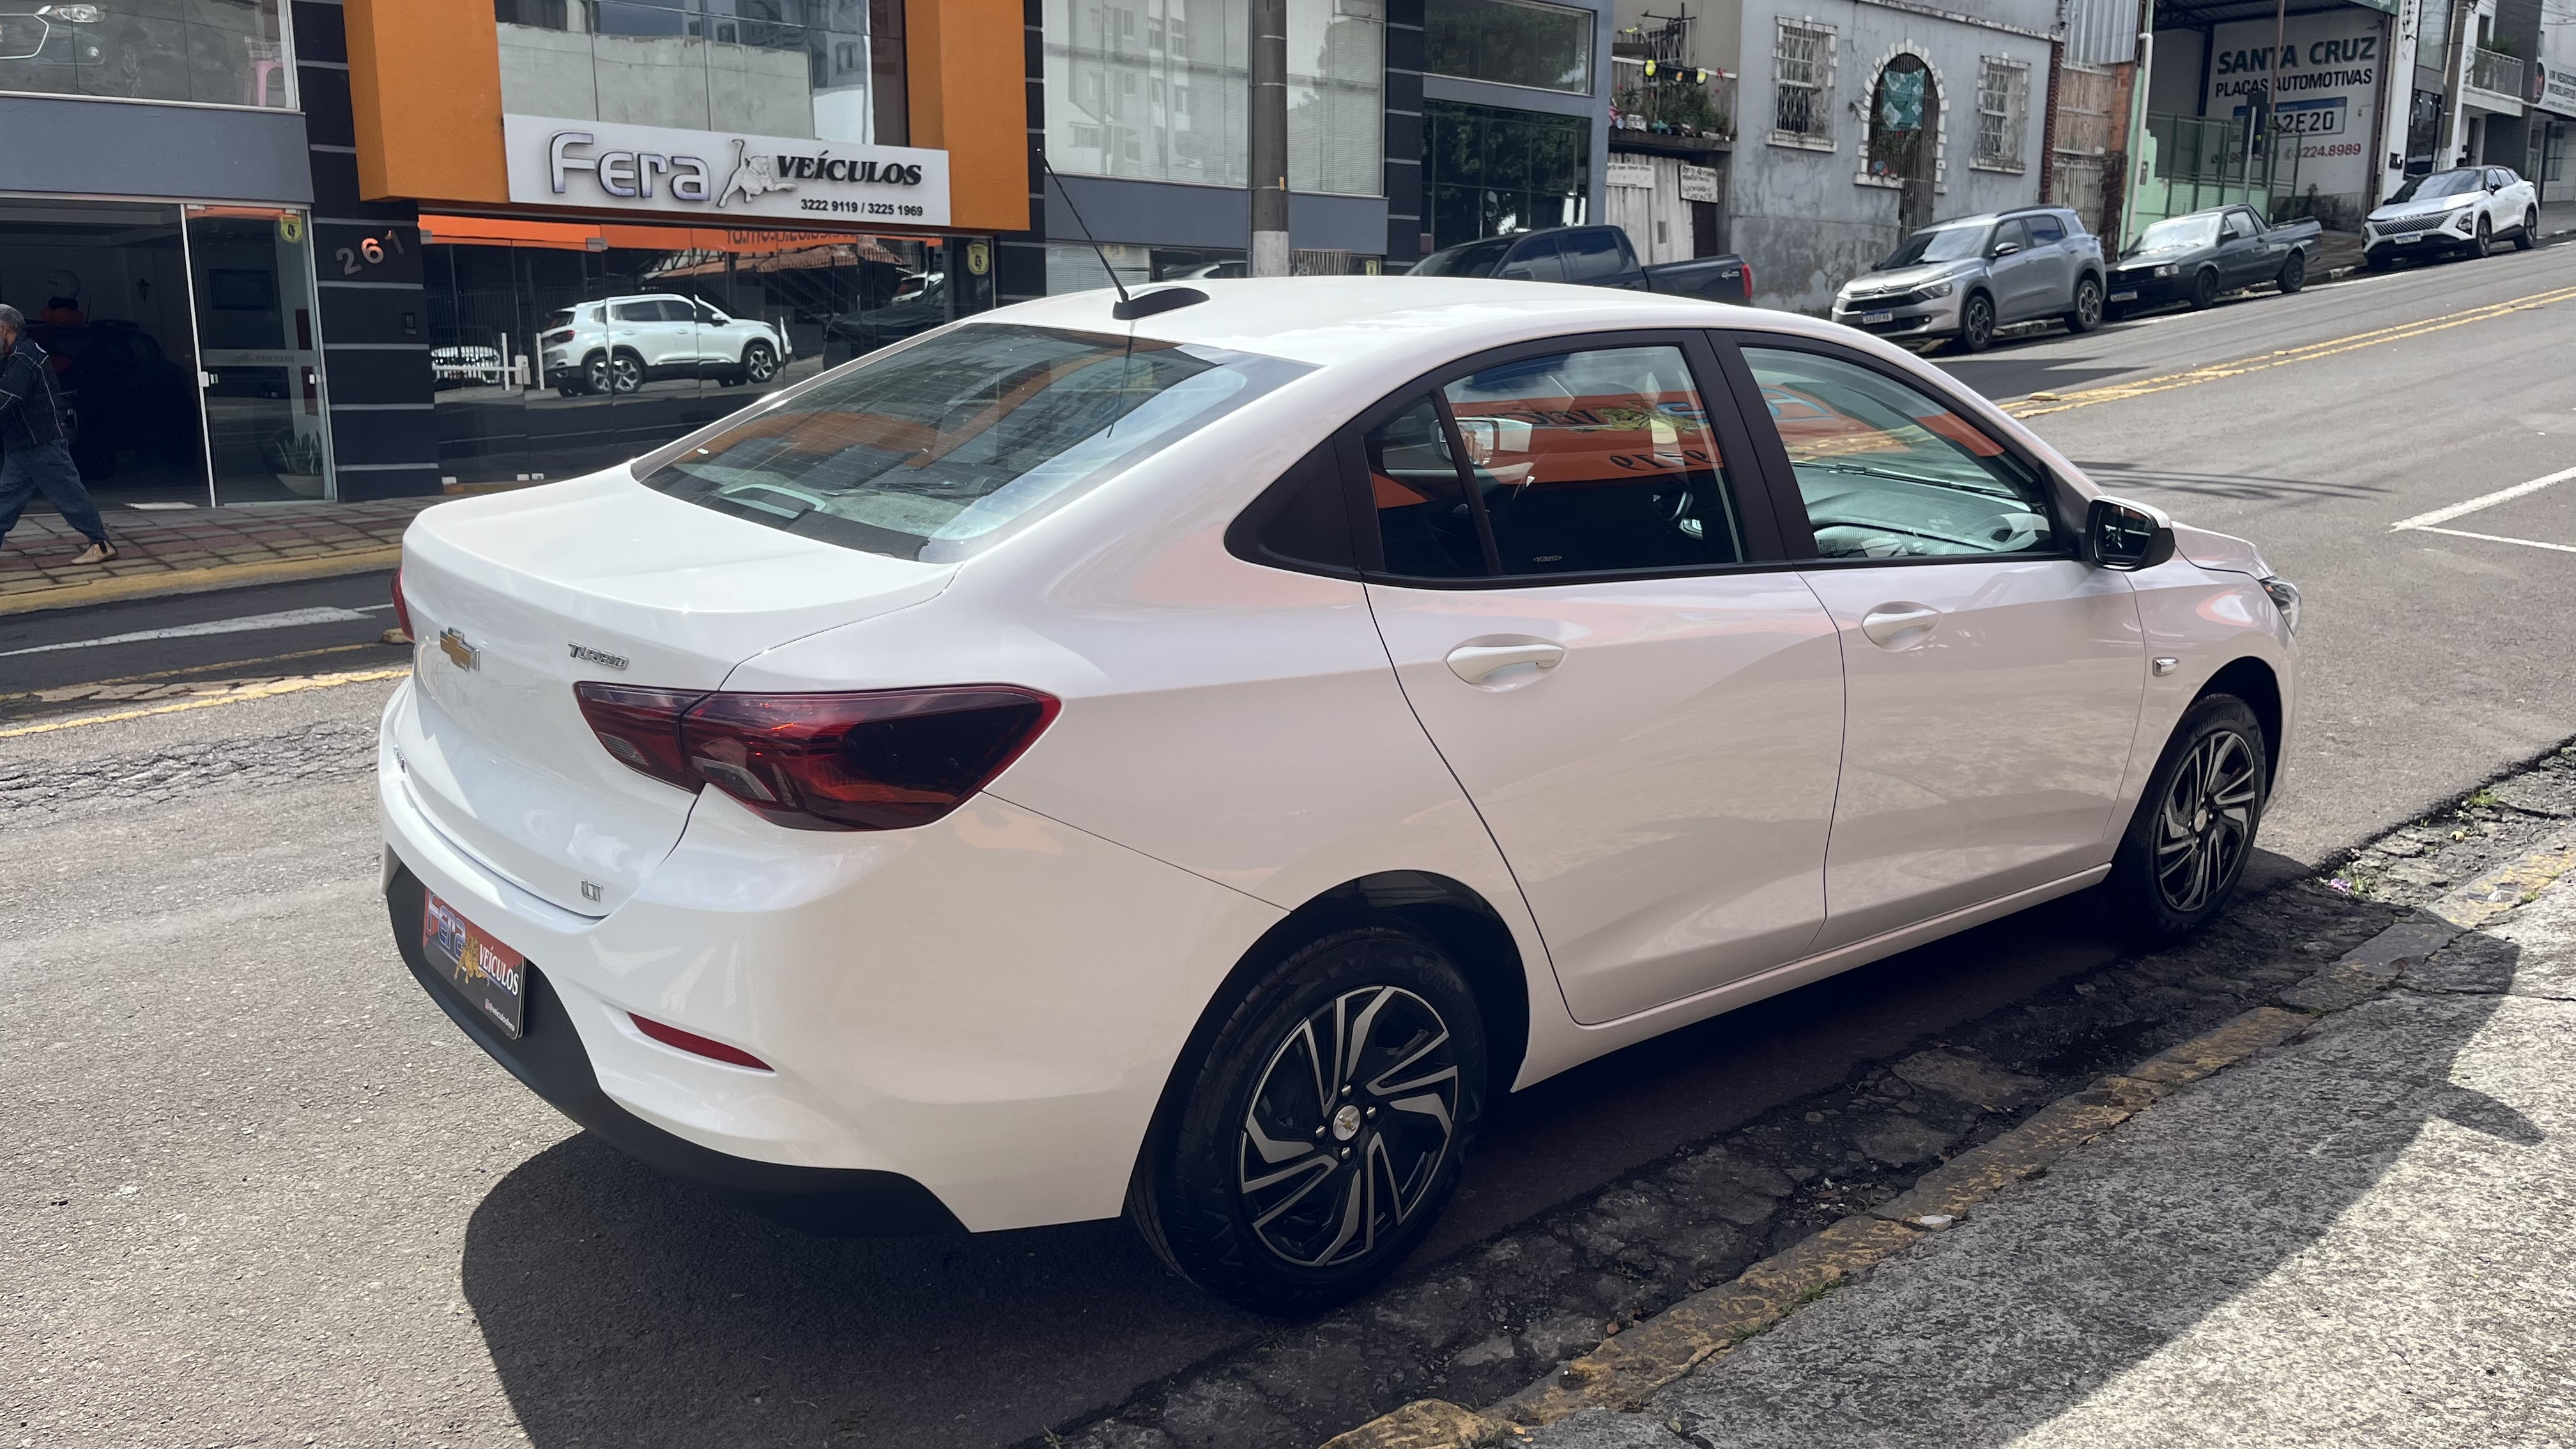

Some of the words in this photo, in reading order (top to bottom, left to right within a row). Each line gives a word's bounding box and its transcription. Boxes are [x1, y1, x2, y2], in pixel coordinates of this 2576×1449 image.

[2218, 45, 2299, 75] SANTA
[2310, 36, 2376, 65] CRUZ
[2216, 77, 2268, 98] PLACAS
[549, 130, 711, 201] Fera
[776, 150, 922, 186] VEÍCULOS
[2301, 143, 2361, 158] 224.8989
[801, 198, 829, 211] 3222
[832, 201, 858, 213] 9119
[868, 203, 894, 215] 3225
[897, 205, 923, 217] 1969
[336, 229, 404, 275] 261
[568, 641, 629, 671] TURBO
[581, 878, 604, 902] LT
[479, 943, 520, 996] VEÍCULOS
